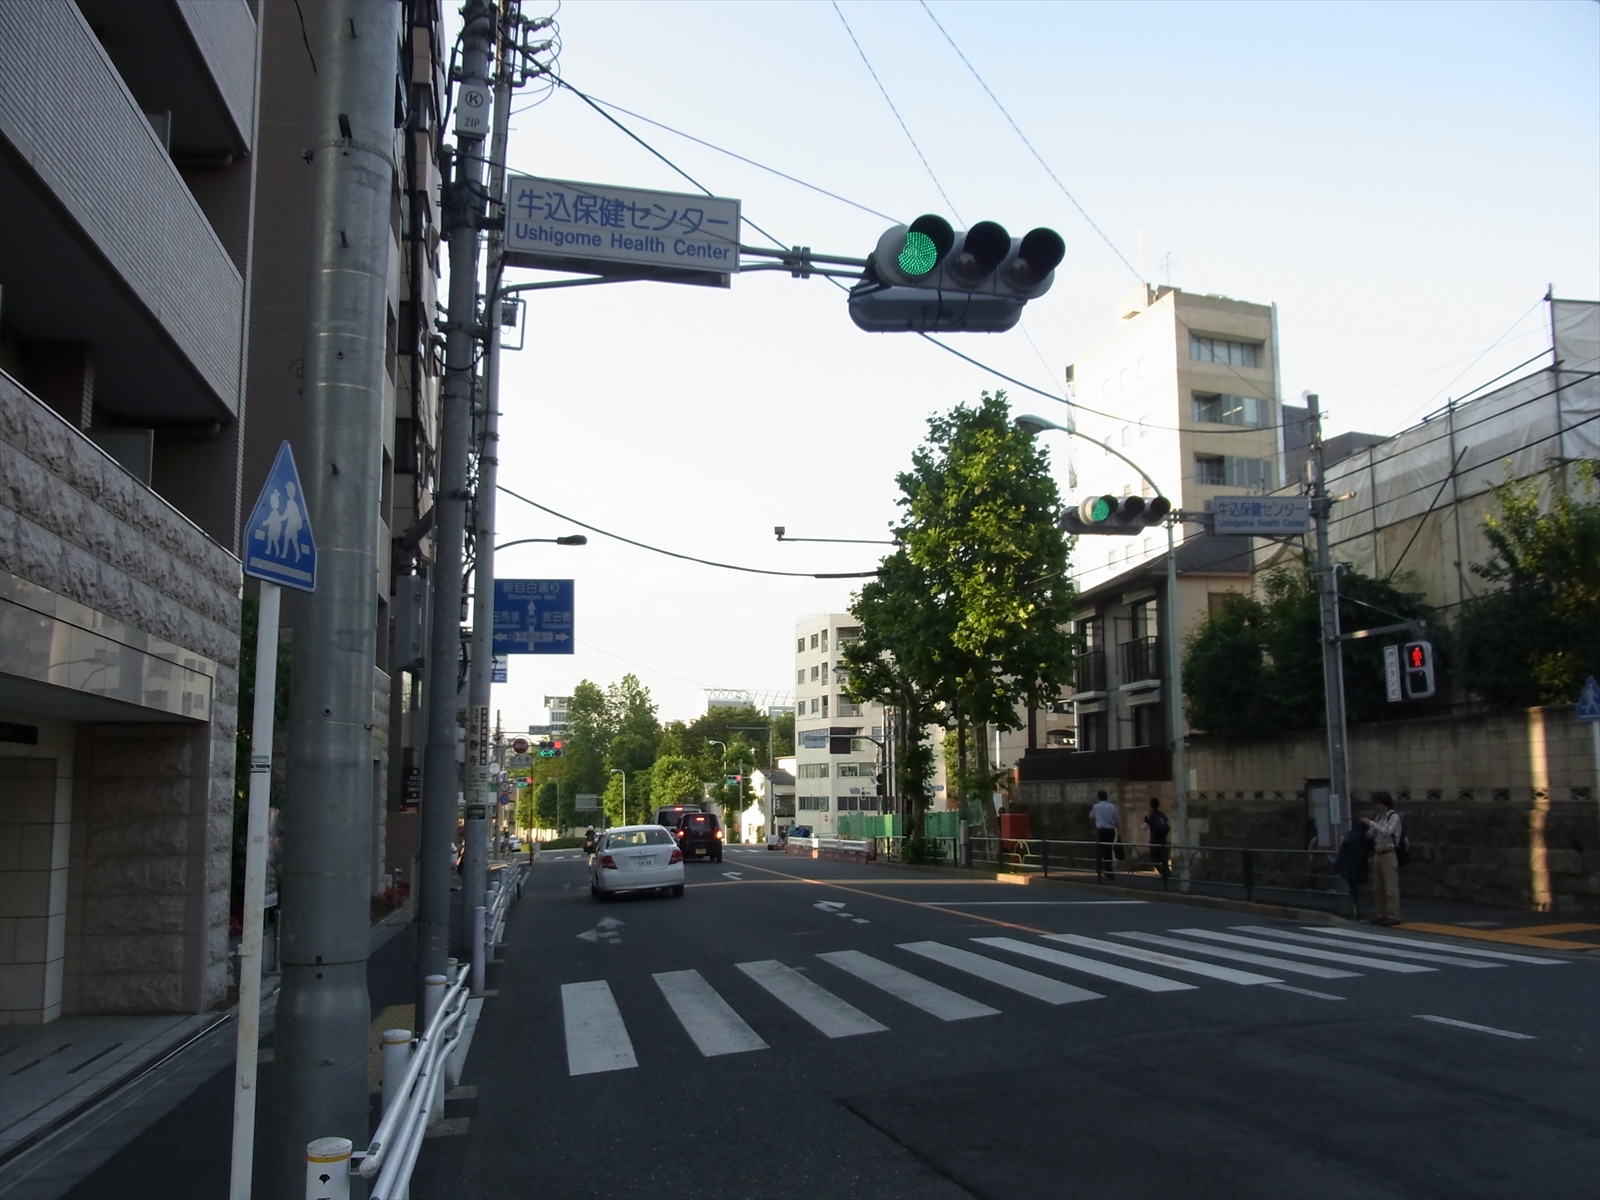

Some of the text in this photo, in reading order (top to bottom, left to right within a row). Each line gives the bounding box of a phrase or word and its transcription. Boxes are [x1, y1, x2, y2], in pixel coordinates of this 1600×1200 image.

[517, 188, 729, 235] 牛込保健センター
[515, 222, 730, 260] Ushigome Health Center
[1218, 502, 1304, 517] 牛込保健センター
[503, 582, 560, 593] 新目白通り
[494, 611, 520, 622] 田馬場
[543, 611, 572, 622] 飯田橋
